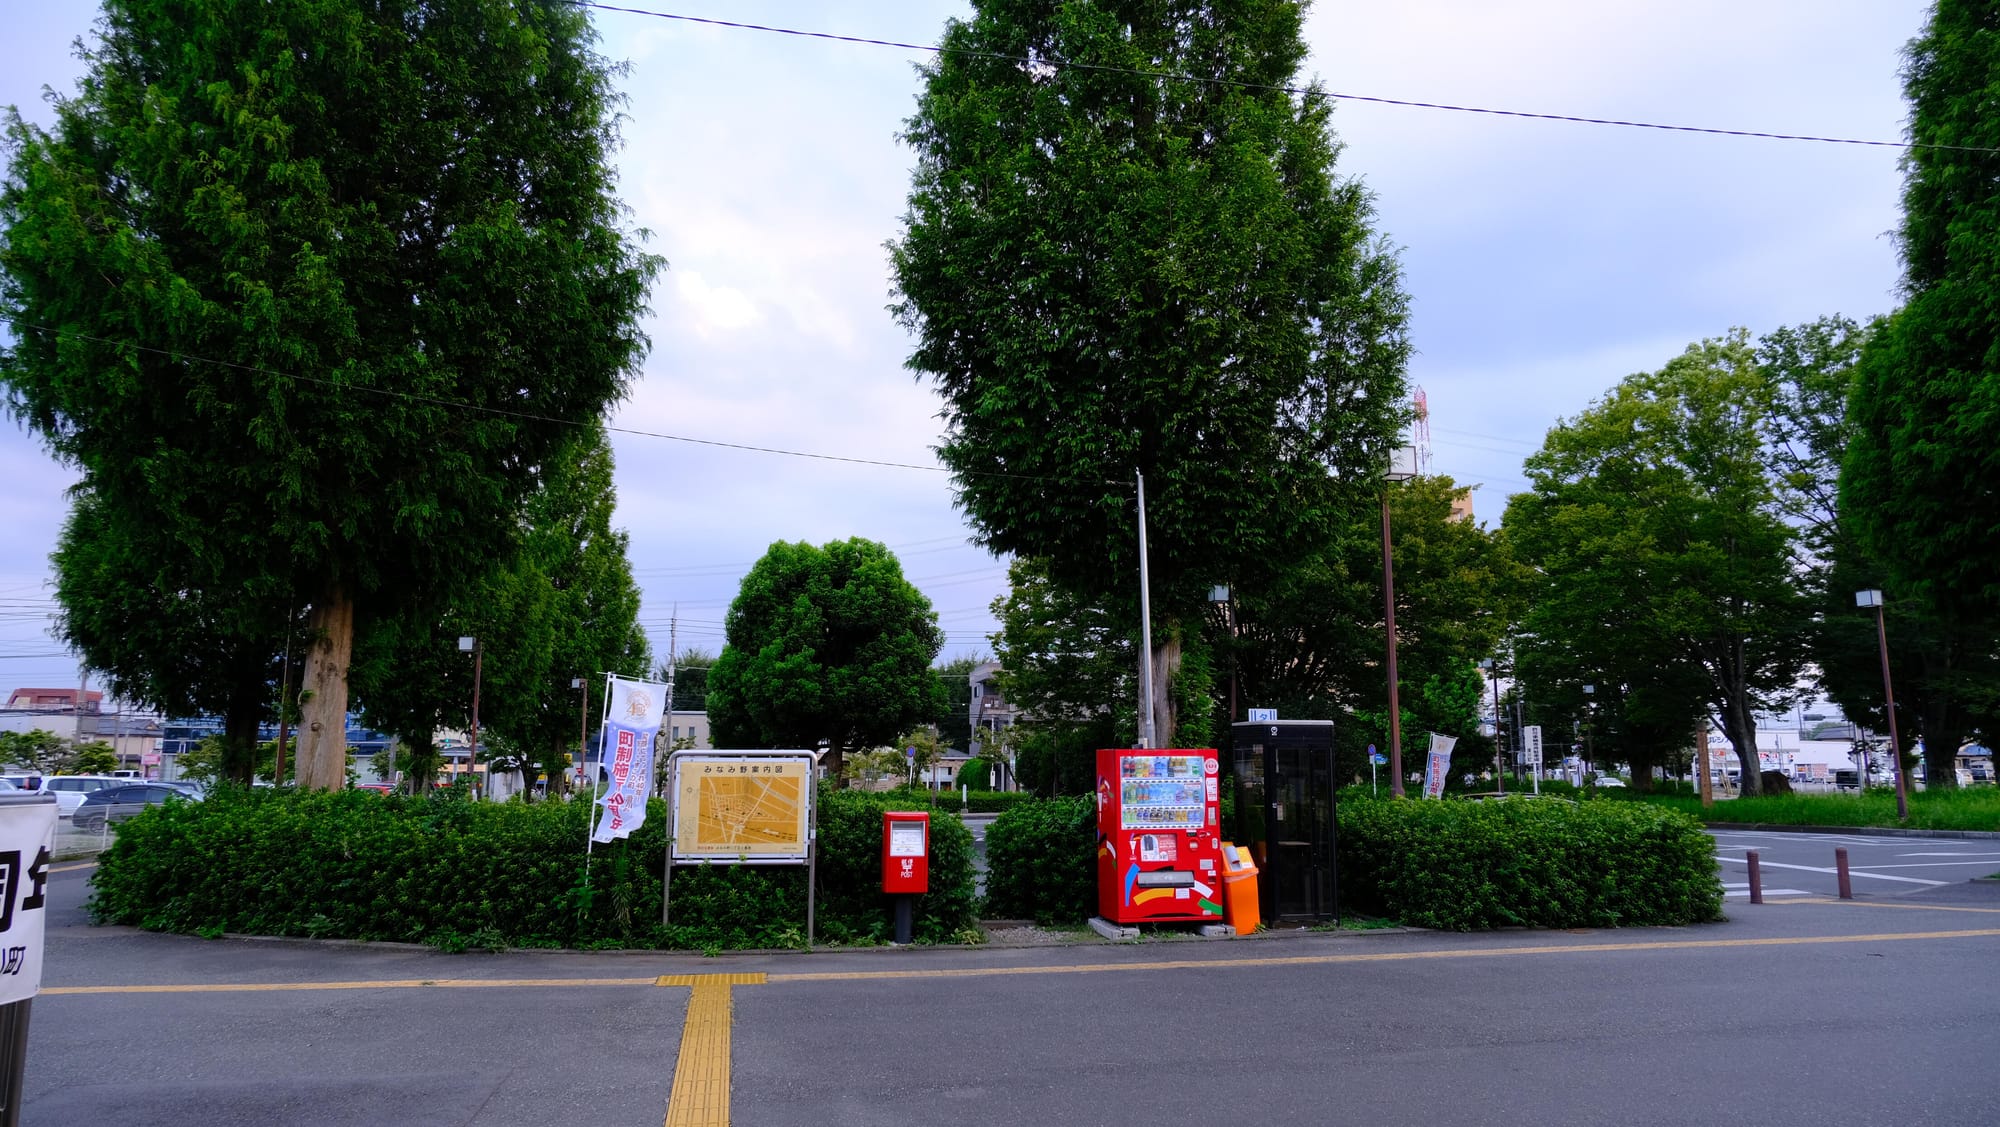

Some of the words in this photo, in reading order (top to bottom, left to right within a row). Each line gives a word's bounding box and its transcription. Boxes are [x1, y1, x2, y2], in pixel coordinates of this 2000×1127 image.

[704, 765, 783, 774] みなみ野案内図
